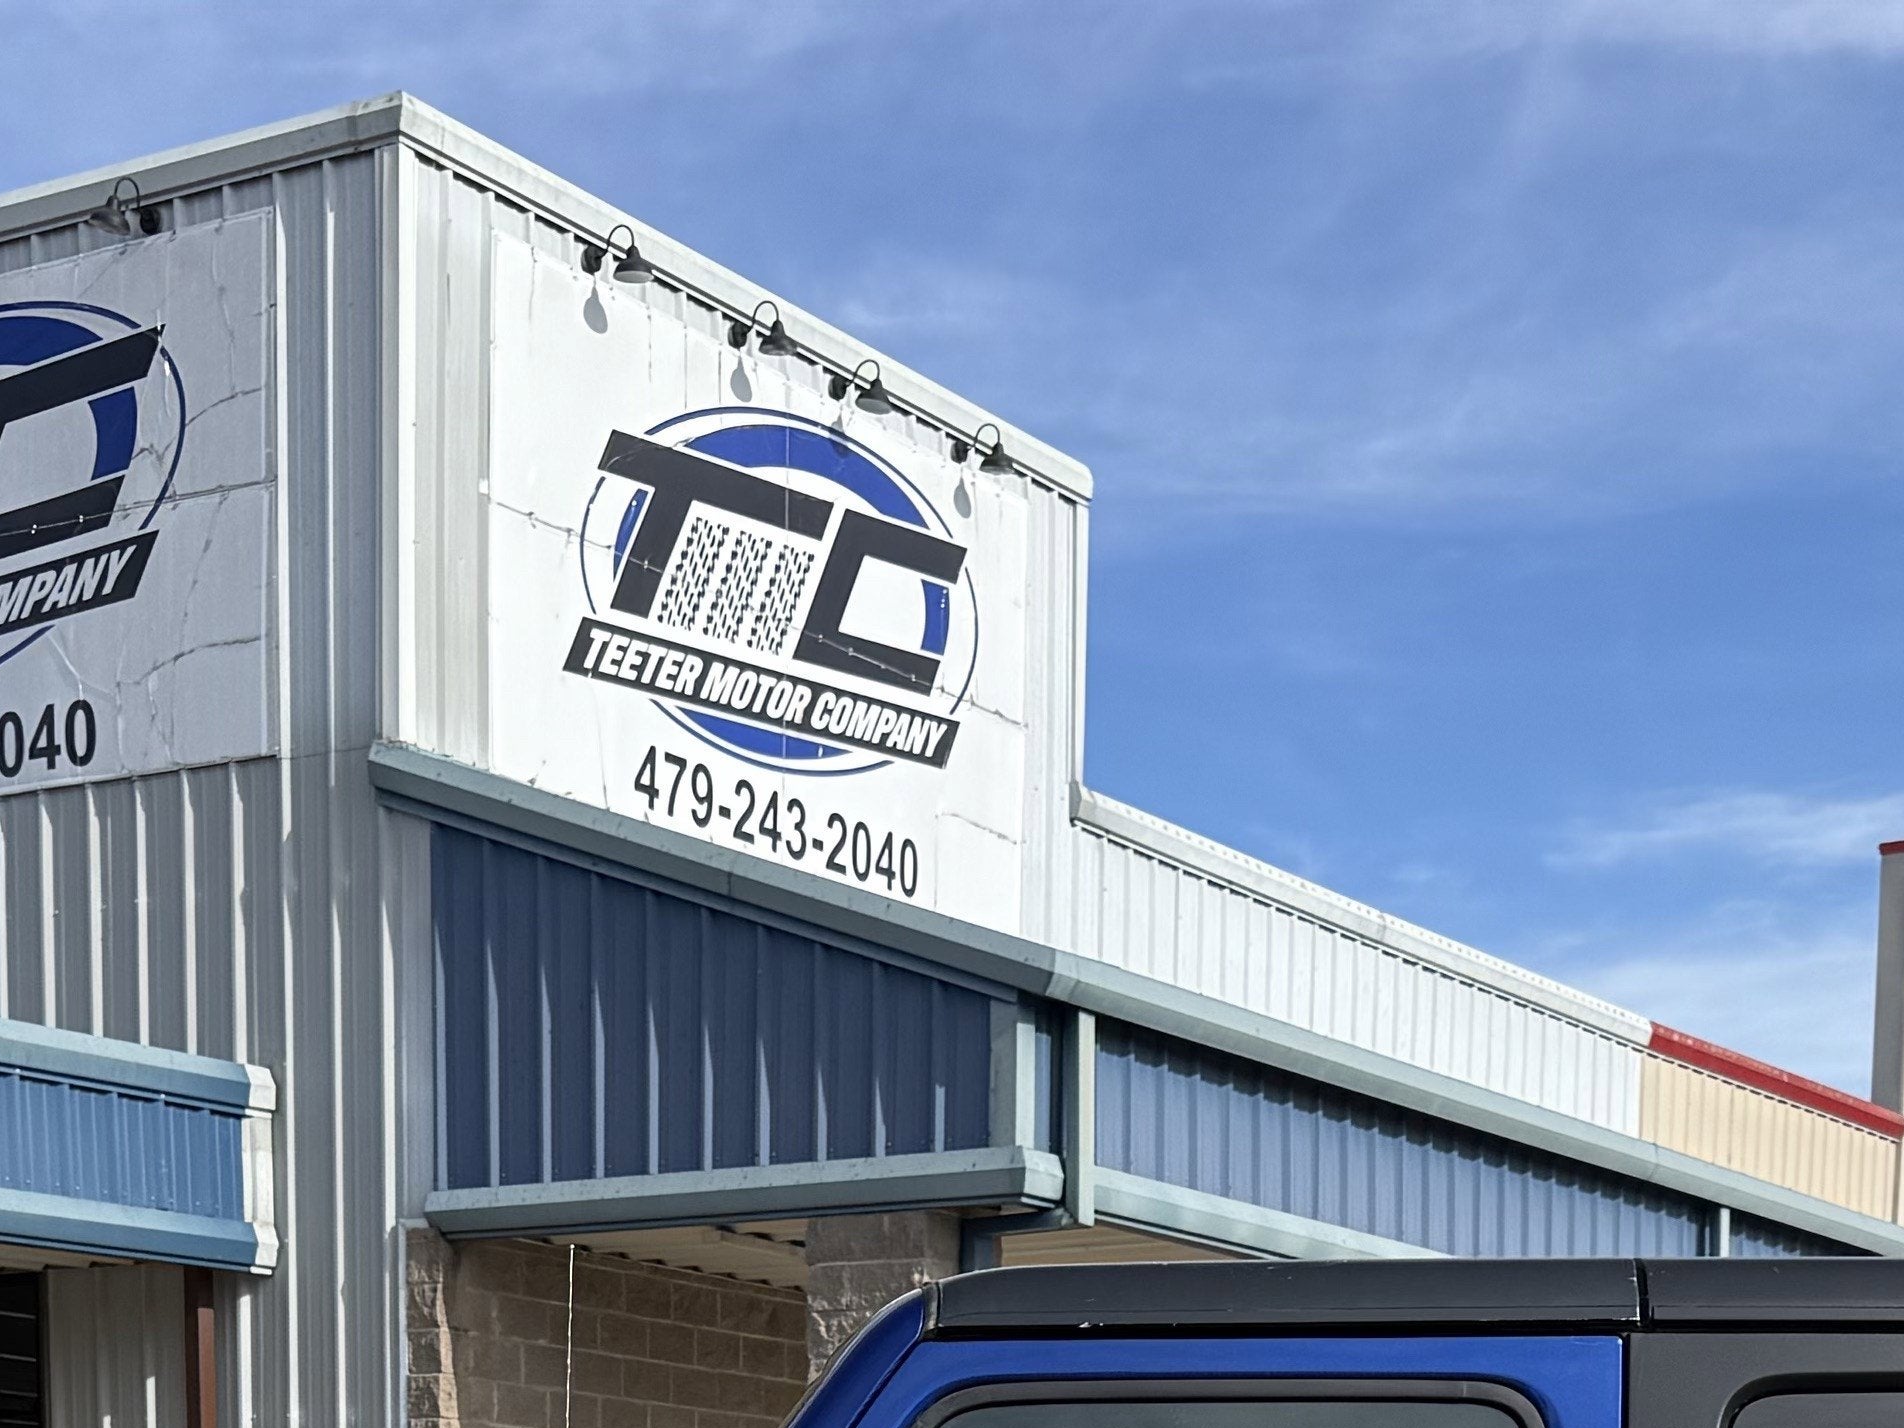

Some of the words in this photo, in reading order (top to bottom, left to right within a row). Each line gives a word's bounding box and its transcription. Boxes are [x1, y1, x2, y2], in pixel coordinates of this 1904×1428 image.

[583, 627, 704, 696] TEETER
[699, 661, 813, 724] MOTOR
[810, 691, 948, 758] COMPANY
[634, 745, 918, 897] 479-243-2040
